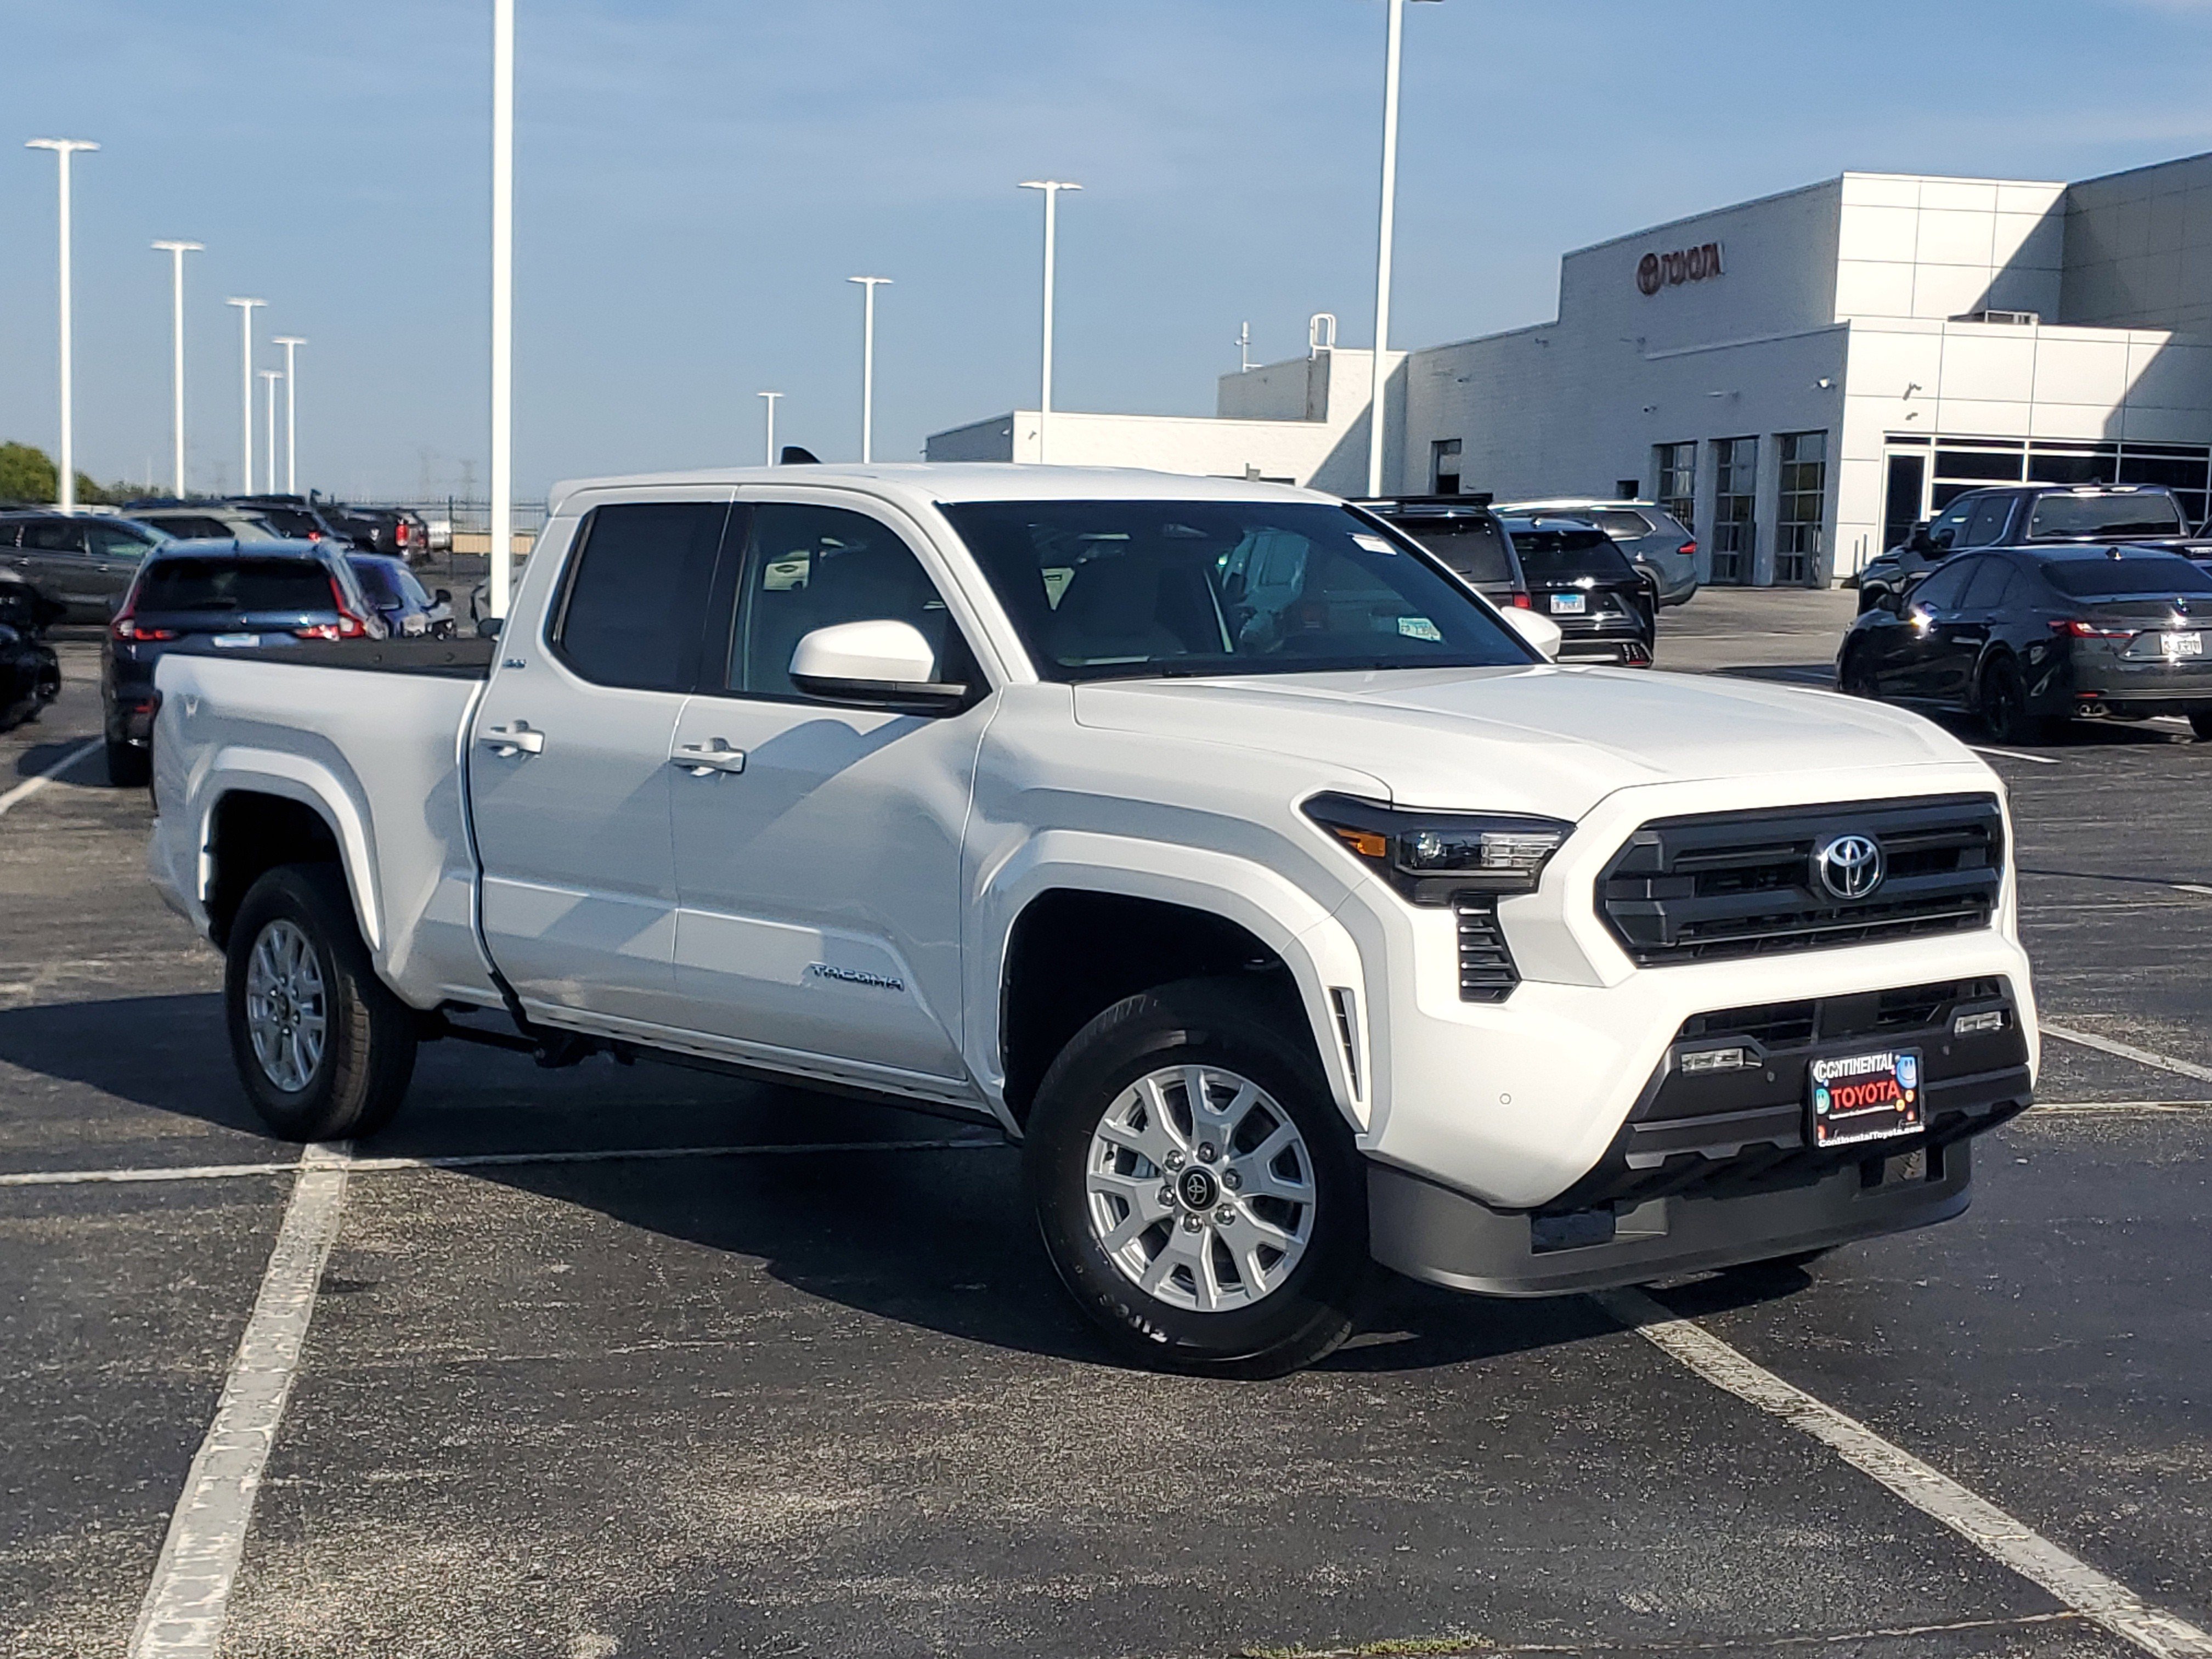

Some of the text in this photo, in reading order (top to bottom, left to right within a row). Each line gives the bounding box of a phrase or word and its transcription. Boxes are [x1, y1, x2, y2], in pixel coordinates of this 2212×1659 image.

[1661, 242, 1725, 285] TOYOTA
[809, 961, 905, 992] TACOMA
[1831, 1079, 1901, 1109] TOYOTA
